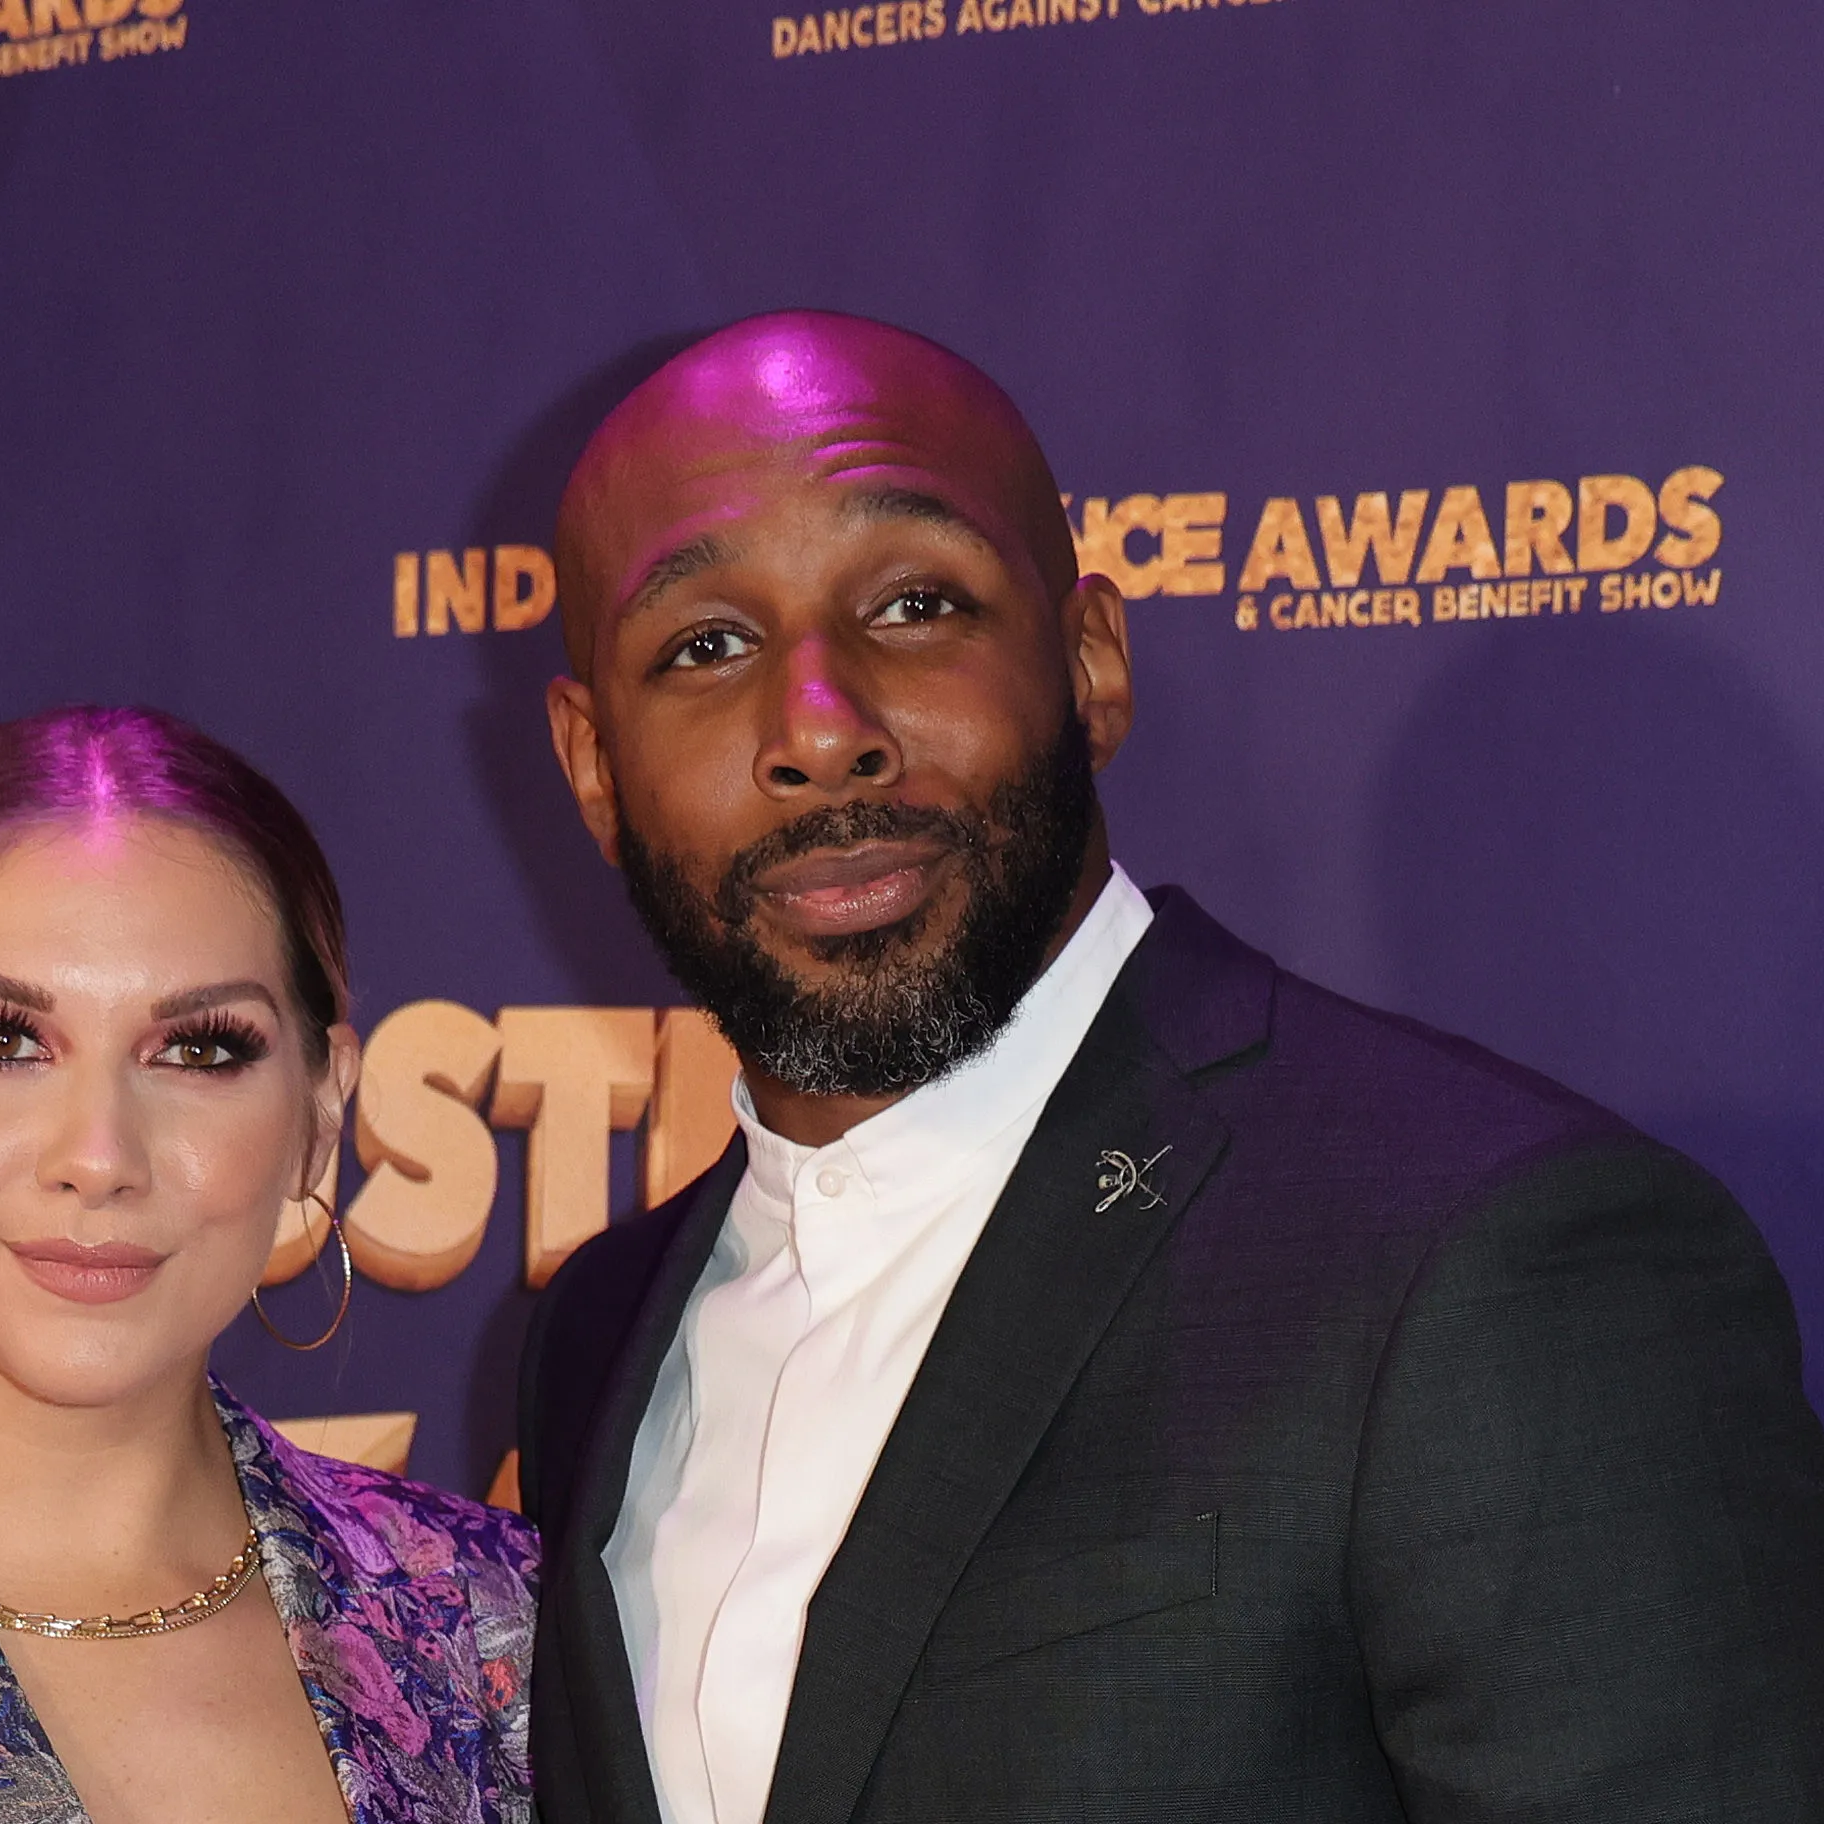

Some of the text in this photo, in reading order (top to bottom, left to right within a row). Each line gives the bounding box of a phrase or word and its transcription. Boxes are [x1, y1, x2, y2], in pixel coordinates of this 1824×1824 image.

[771, 0, 946, 58] DANCERS
[1238, 465, 1724, 591] AWARDS
[1236, 568, 1721, 632] & CANCER BENEFIT SHOW
